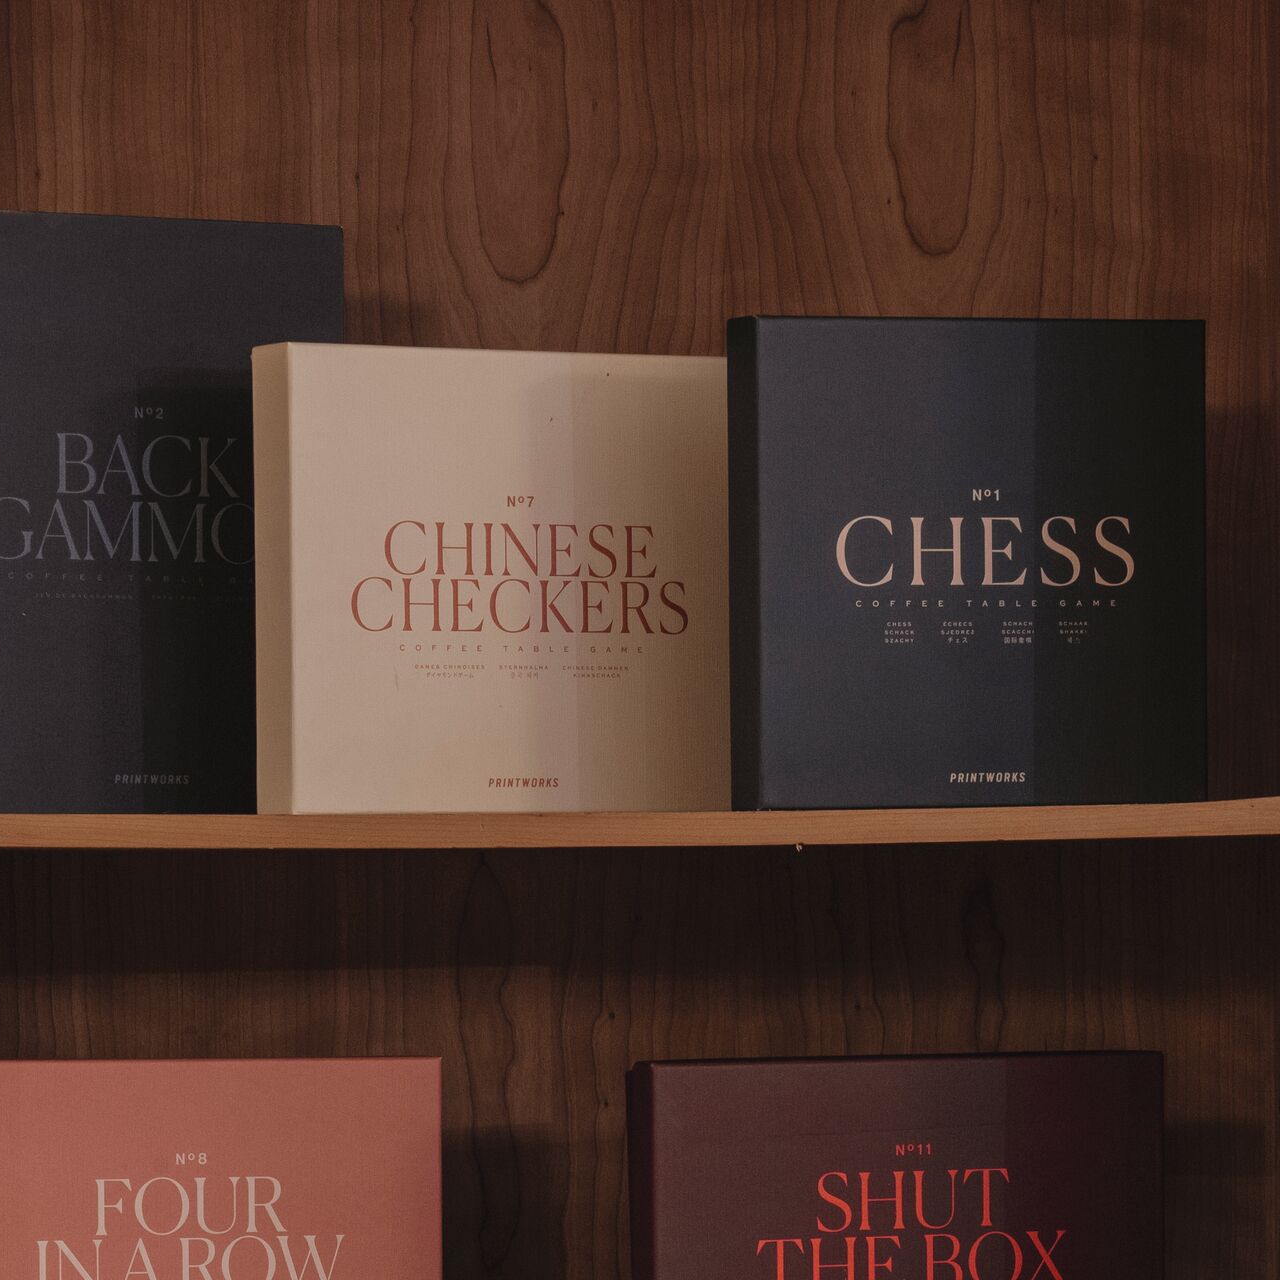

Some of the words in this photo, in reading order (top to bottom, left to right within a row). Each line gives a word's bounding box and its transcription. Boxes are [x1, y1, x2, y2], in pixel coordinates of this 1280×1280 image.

[56, 432, 240, 498] BACK
[384, 520, 658, 578] CHINESE
[835, 515, 1135, 587] CHESS
[351, 576, 689, 635] CHECKERS
[855, 599, 945, 608] COFFEE
[966, 599, 1038, 608] TABLE
[1059, 599, 1117, 608] GAME
[399, 643, 484, 653] COFFEE
[503, 644, 570, 654] TABLE
[590, 645, 644, 655] GAME
[114, 773, 190, 785] PRINTWORKS
[488, 777, 559, 788] PRINTWORKS
[949, 772, 1026, 783] PRINTWORKS
[95, 1176, 288, 1236] FOUR
[816, 1167, 1010, 1233] SHUT
